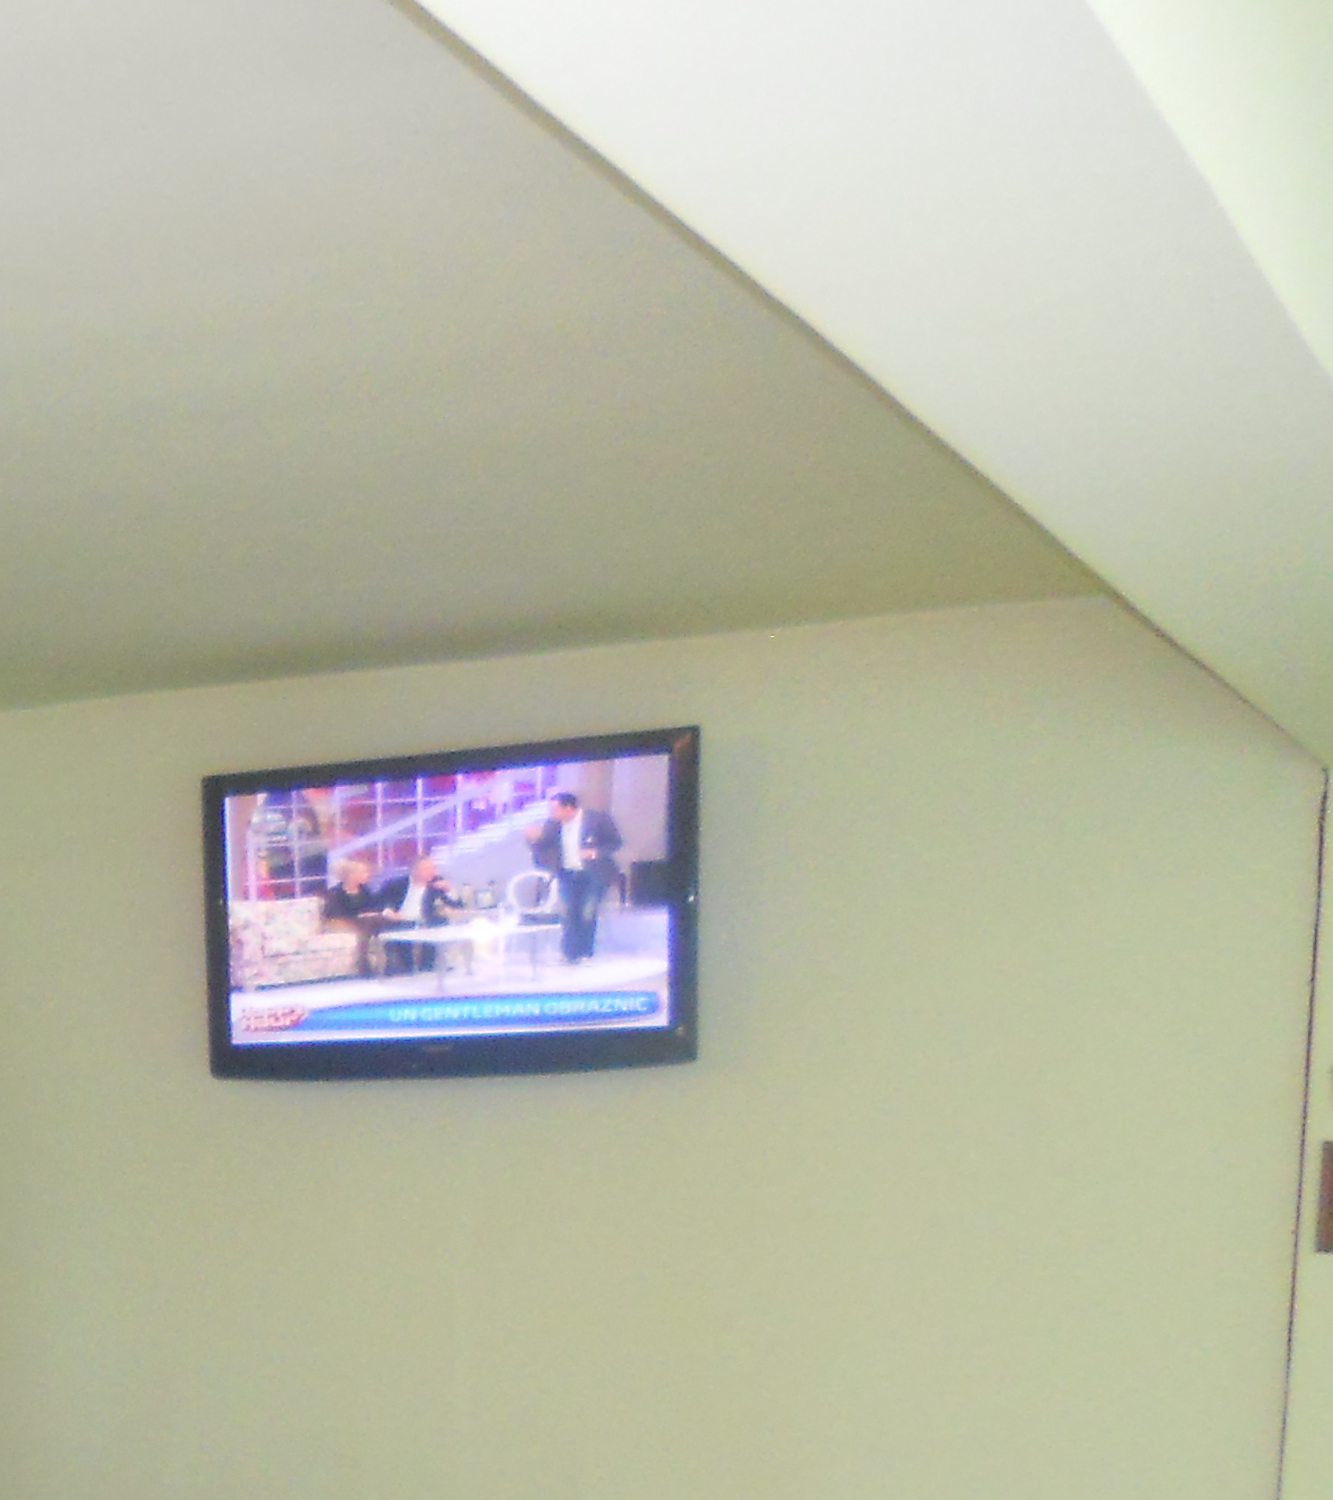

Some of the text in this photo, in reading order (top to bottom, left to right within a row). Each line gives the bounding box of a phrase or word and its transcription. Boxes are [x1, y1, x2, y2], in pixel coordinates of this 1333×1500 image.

[389, 997, 648, 1022] UN GENTLEMAN OBRAZNIC
